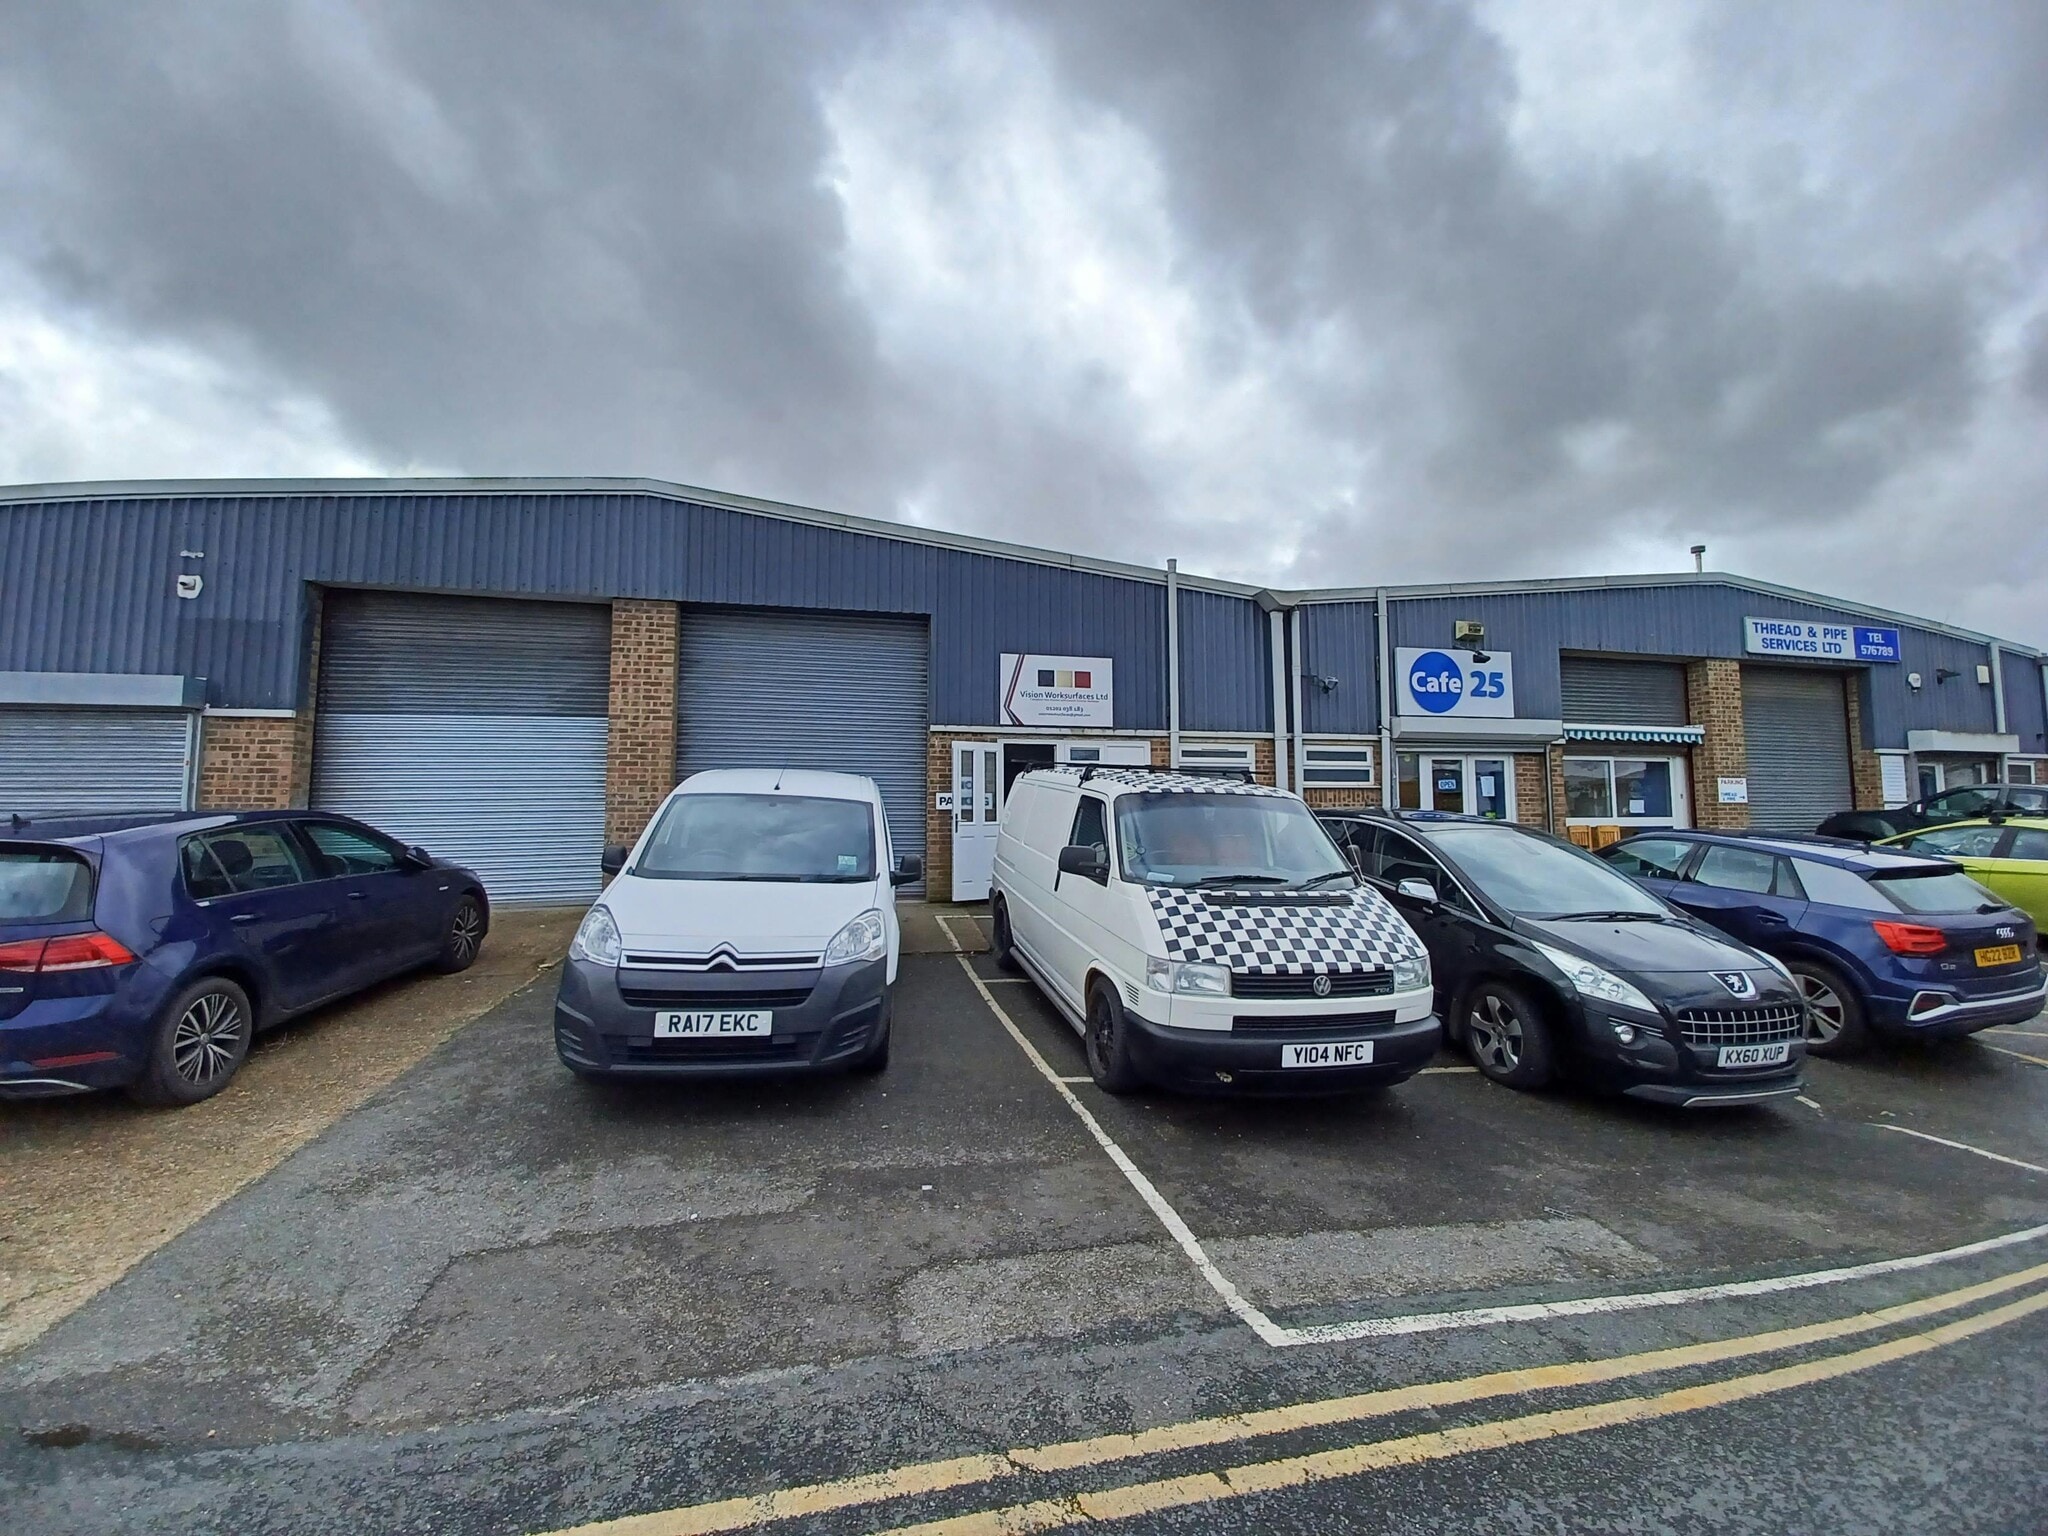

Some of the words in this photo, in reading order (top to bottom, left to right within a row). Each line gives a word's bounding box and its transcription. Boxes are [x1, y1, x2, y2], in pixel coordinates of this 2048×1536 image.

[1752, 621, 1801, 637] THREAD
[1807, 626, 1817, 638] &
[1823, 627, 1848, 641] PIPE
[1866, 632, 1885, 644] TEL
[1761, 637, 1817, 652] SERVICES
[1822, 642, 1842, 654] LTD
[1860, 644, 1894, 657] 576789
[1411, 671, 1462, 694] Cafe
[1470, 671, 1505, 698] 25
[1020, 690, 1043, 699] Vision
[1044, 691, 1094, 700] Worksurfaces
[1095, 693, 1108, 701] Ltd
[668, 1014, 715, 1033] RA17
[719, 1013, 759, 1032] EKC
[1294, 1046, 1329, 1063] Y104
[1334, 1044, 1364, 1062] NFC
[1725, 1049, 1759, 1064] KX60
[1761, 1046, 1784, 1061] XUP
